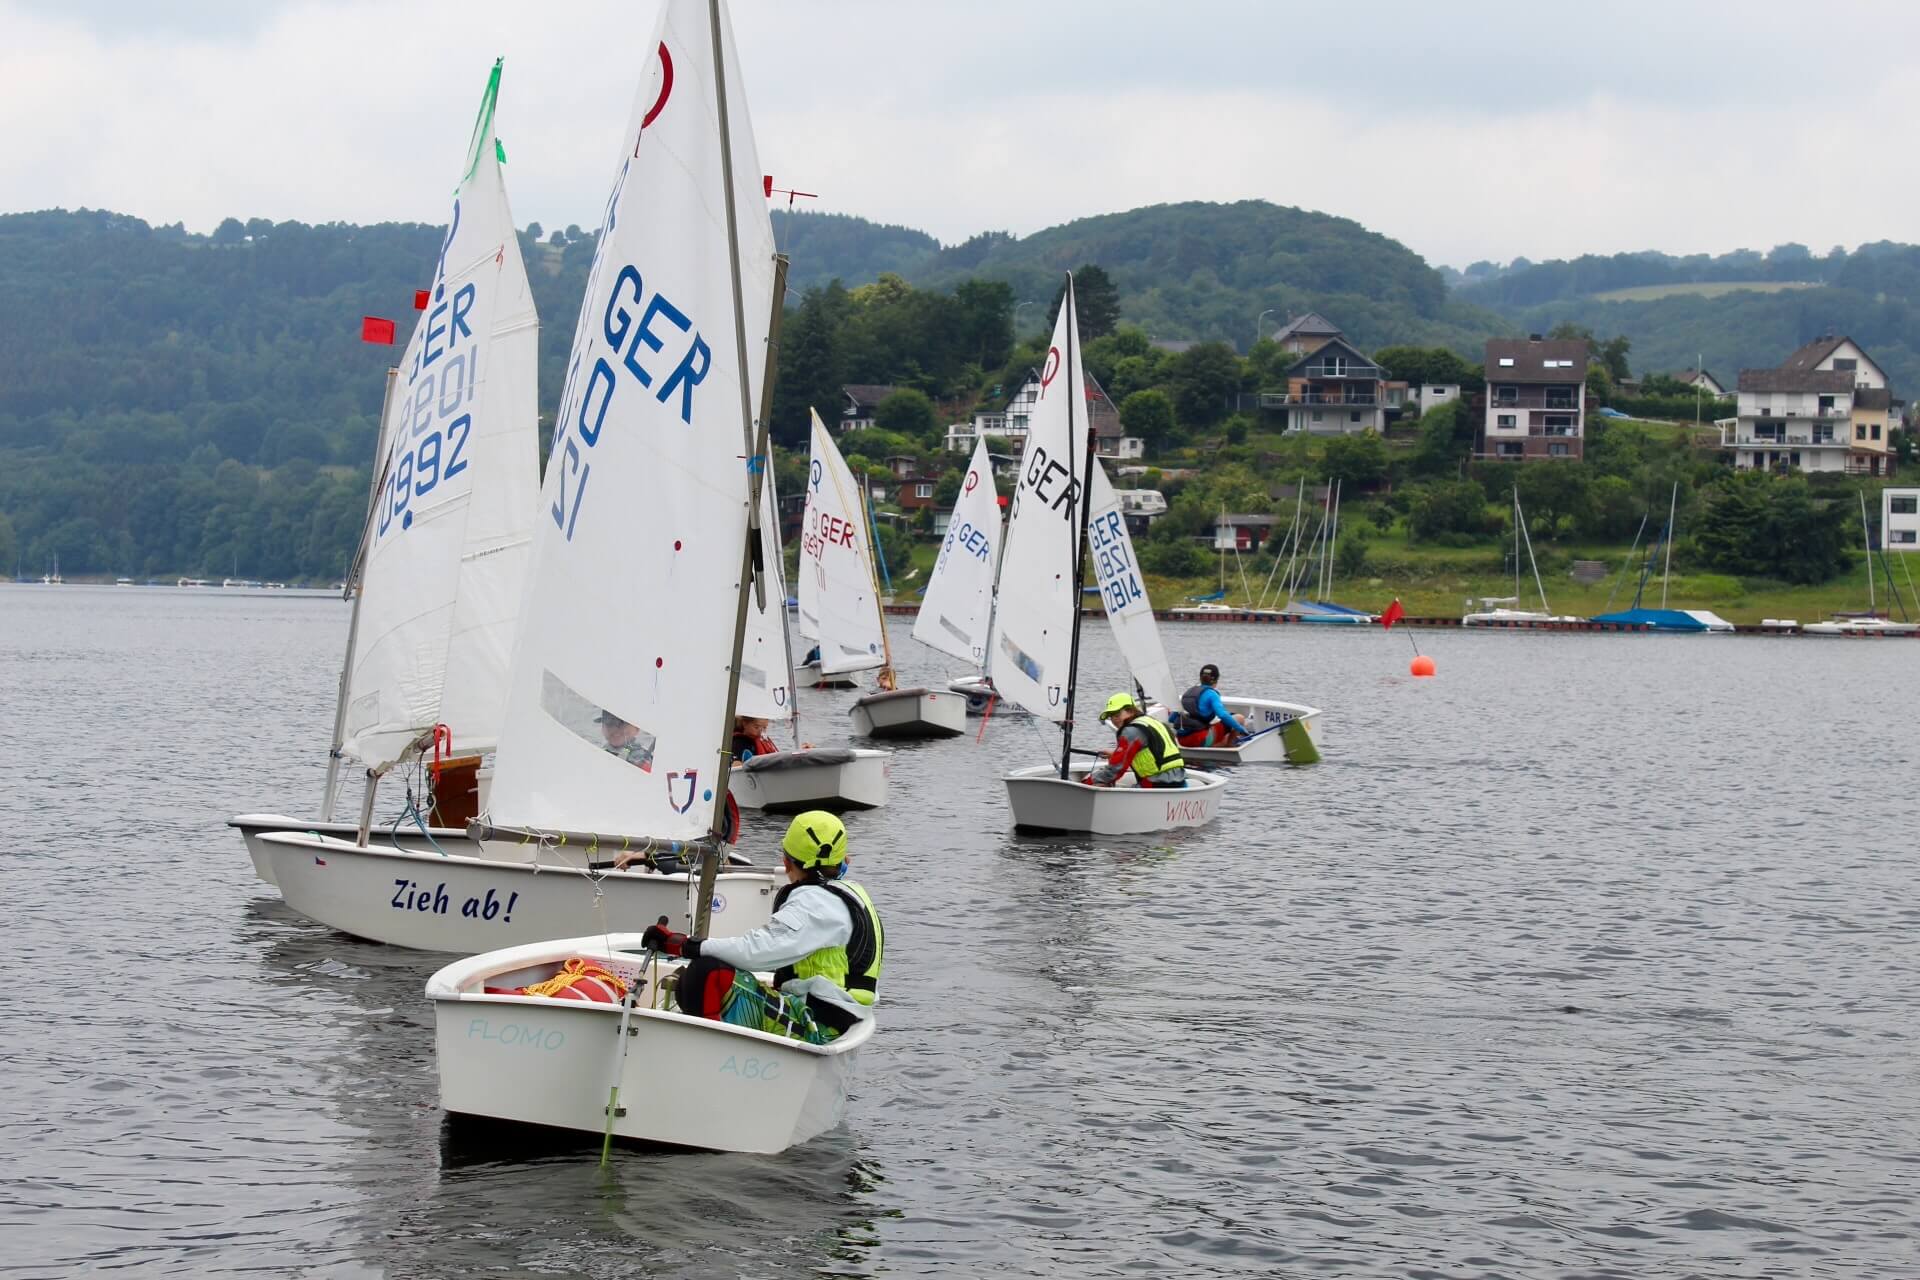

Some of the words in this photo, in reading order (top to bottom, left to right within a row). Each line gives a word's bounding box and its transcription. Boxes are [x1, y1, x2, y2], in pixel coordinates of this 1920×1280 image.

[604, 265, 711, 424] GER
[1027, 447, 1081, 521] GER
[821, 513, 854, 549] GER
[959, 523, 989, 563] GER
[1089, 511, 1124, 550] GER
[1265, 711, 1281, 723] FAR
[1283, 712, 1302, 721] EA
[391, 879, 449, 914] Zieh
[461, 888, 519, 923] ab!
[468, 1019, 565, 1050] FLOMO
[720, 1055, 779, 1080] ABC
